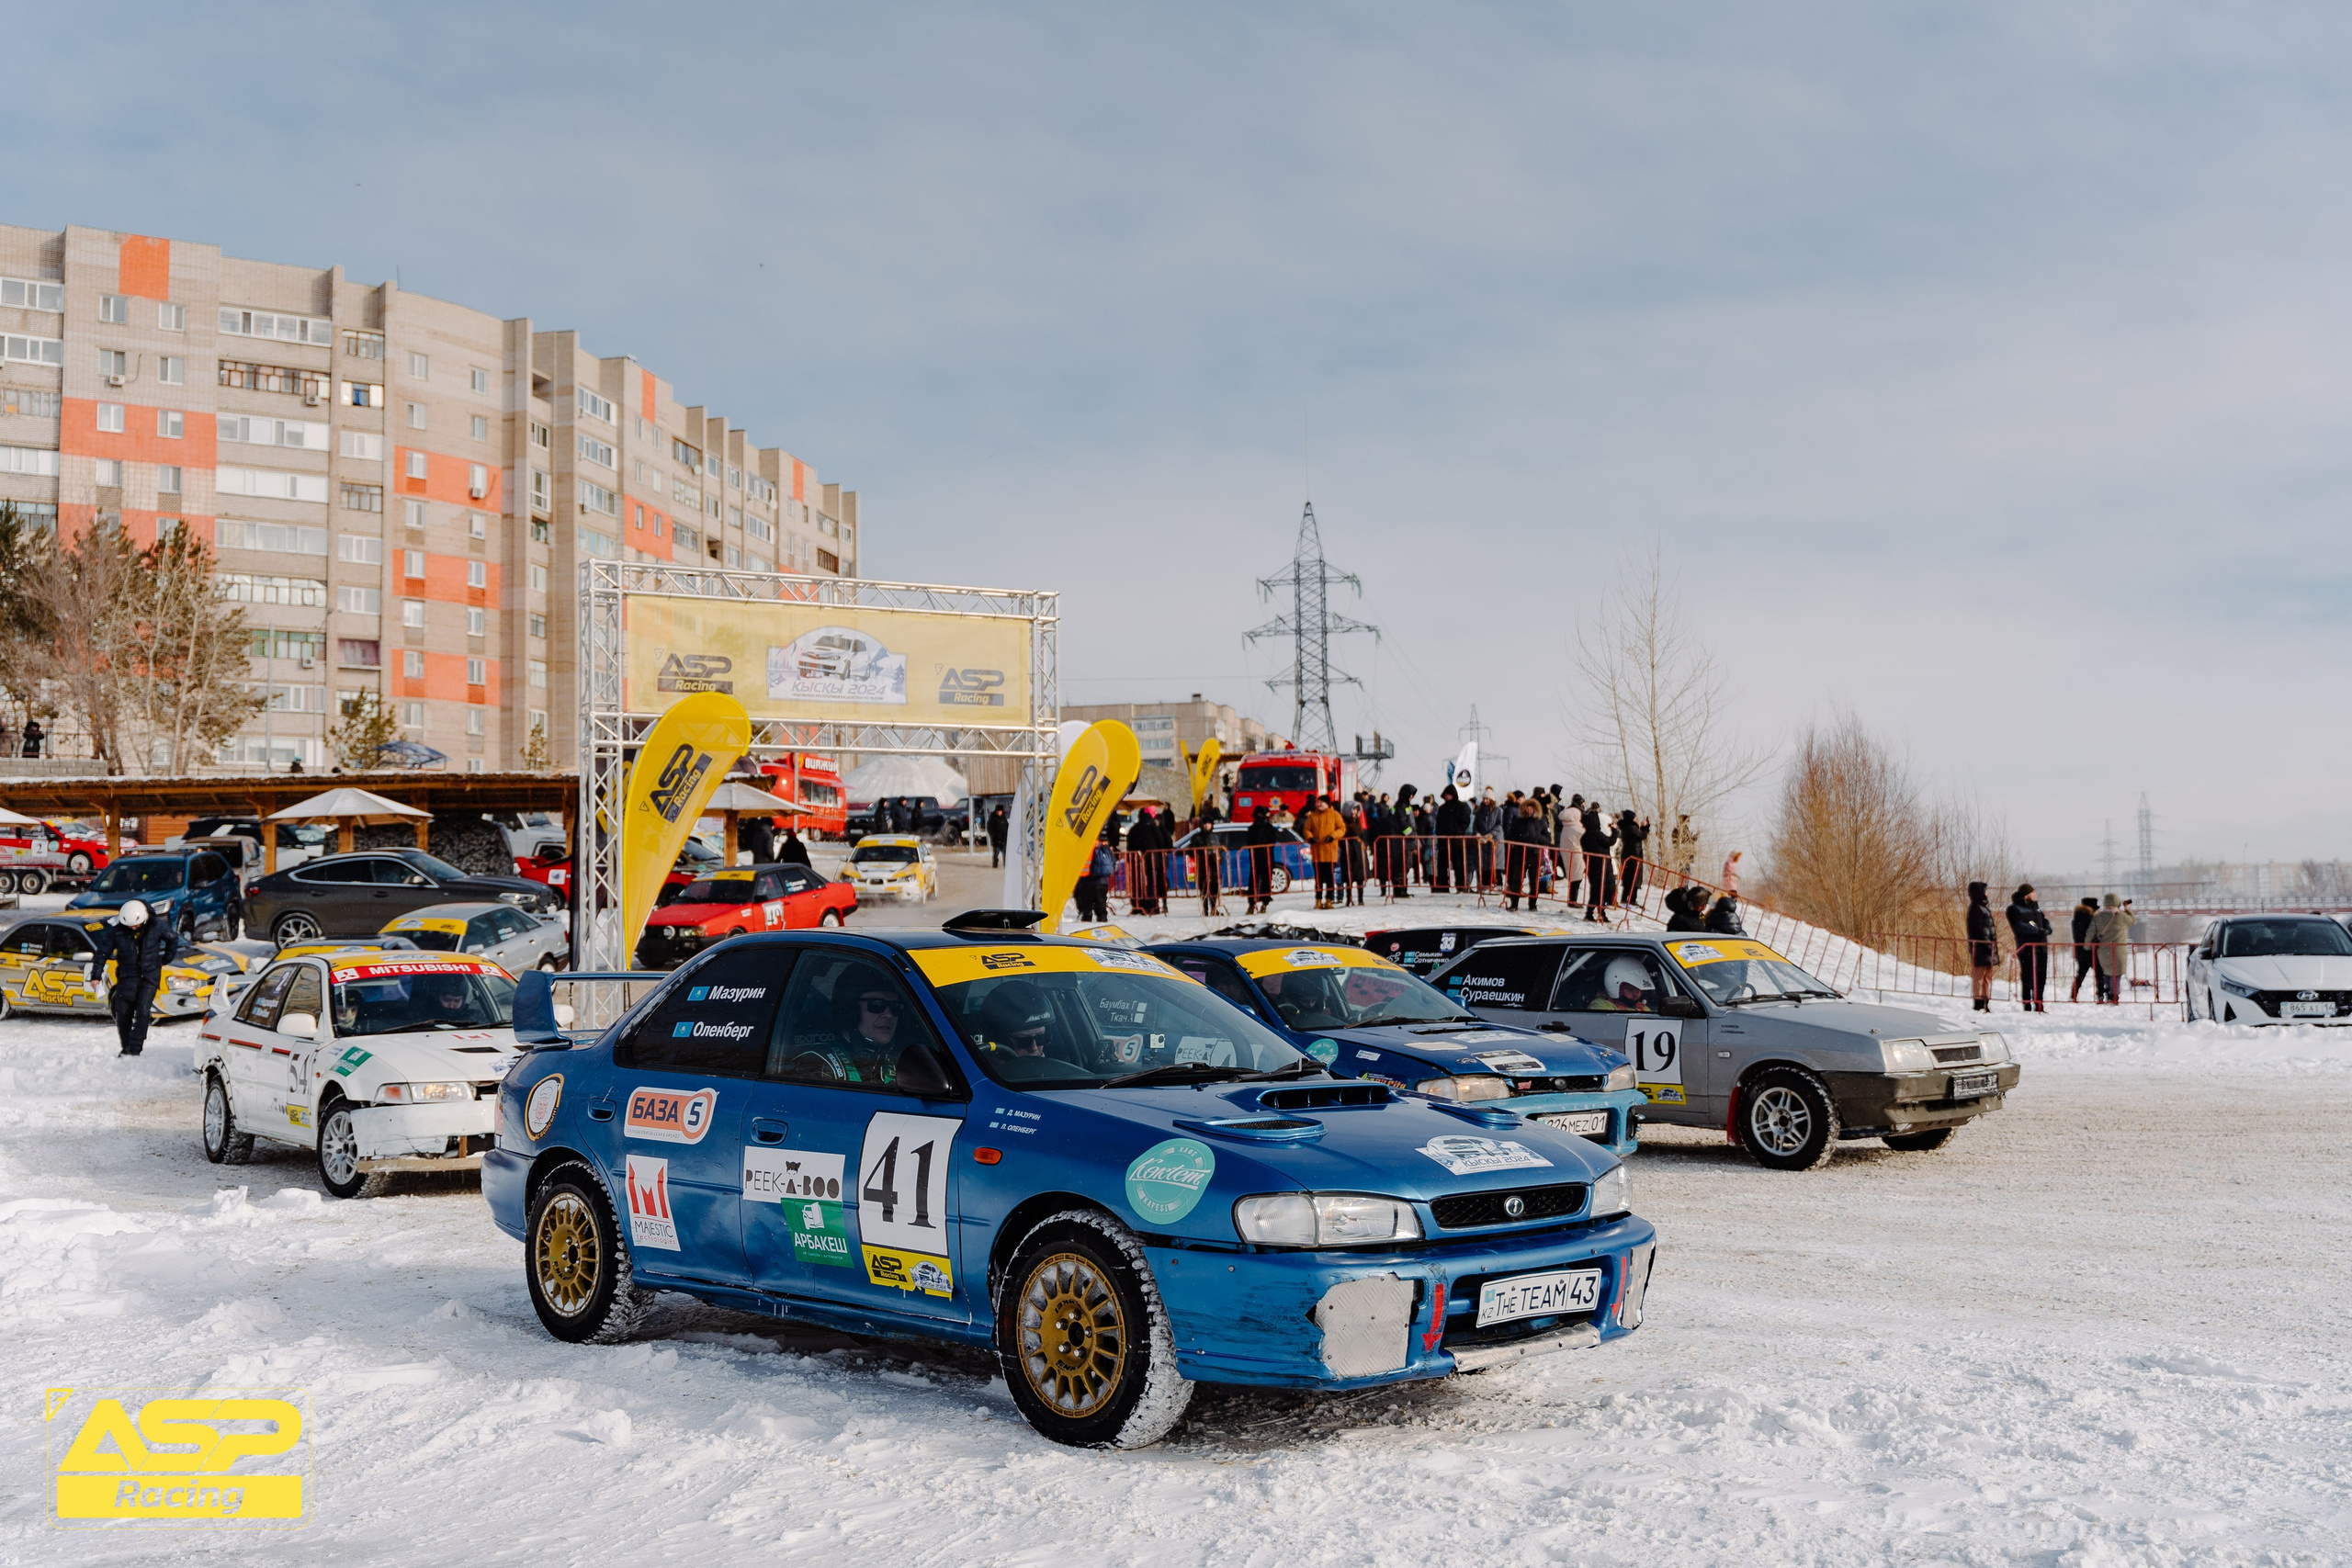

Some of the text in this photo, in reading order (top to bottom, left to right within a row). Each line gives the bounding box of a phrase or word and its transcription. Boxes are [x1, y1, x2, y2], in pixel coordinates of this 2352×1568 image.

[658, 653, 732, 678] ASP
[674, 680, 717, 693] Racing
[938, 668, 1005, 691] ASP
[847, 683, 888, 695] 2024
[953, 692, 991, 705] Racing
[649, 743, 694, 817] ASP
[673, 768, 702, 807] Racing
[1064, 765, 1098, 831] ASP
[1080, 788, 1103, 824] Racing
[1440, 936, 1456, 950] 33
[980, 953, 1026, 964] ASP
[368, 964, 471, 975] MITSUBISHI
[1463, 974, 1505, 987] Акимов
[40, 993, 73, 1007] Racing
[708, 986, 766, 1002] Мазурин
[1460, 987, 1525, 1002] Сураешкин
[1099, 998, 1131, 1010] Баумбах
[693, 1021, 754, 1041] Оленберг
[1125, 1042, 1136, 1056] 5
[1631, 1031, 1676, 1073] 19
[289, 1053, 311, 1095] 54
[632, 1097, 704, 1126] БАЗА 5
[1014, 1110, 1042, 1121] МАЗУРИН
[1007, 1124, 1038, 1135] ОЛЕНБЕРГ
[1591, 1115, 1606, 1132] 01
[745, 1169, 840, 1199] PEEK-A-BOO
[863, 1135, 937, 1229] 41
[634, 1220, 673, 1238] MAJESTIC
[636, 1234, 676, 1245] technologies
[794, 1232, 848, 1254] АРБАКЕШ
[871, 1254, 902, 1271] ASP
[879, 1270, 900, 1280] Racing
[1521, 1283, 1567, 1312] TEAM
[1570, 1276, 1597, 1304] 43
[1481, 1307, 1494, 1320] KZ
